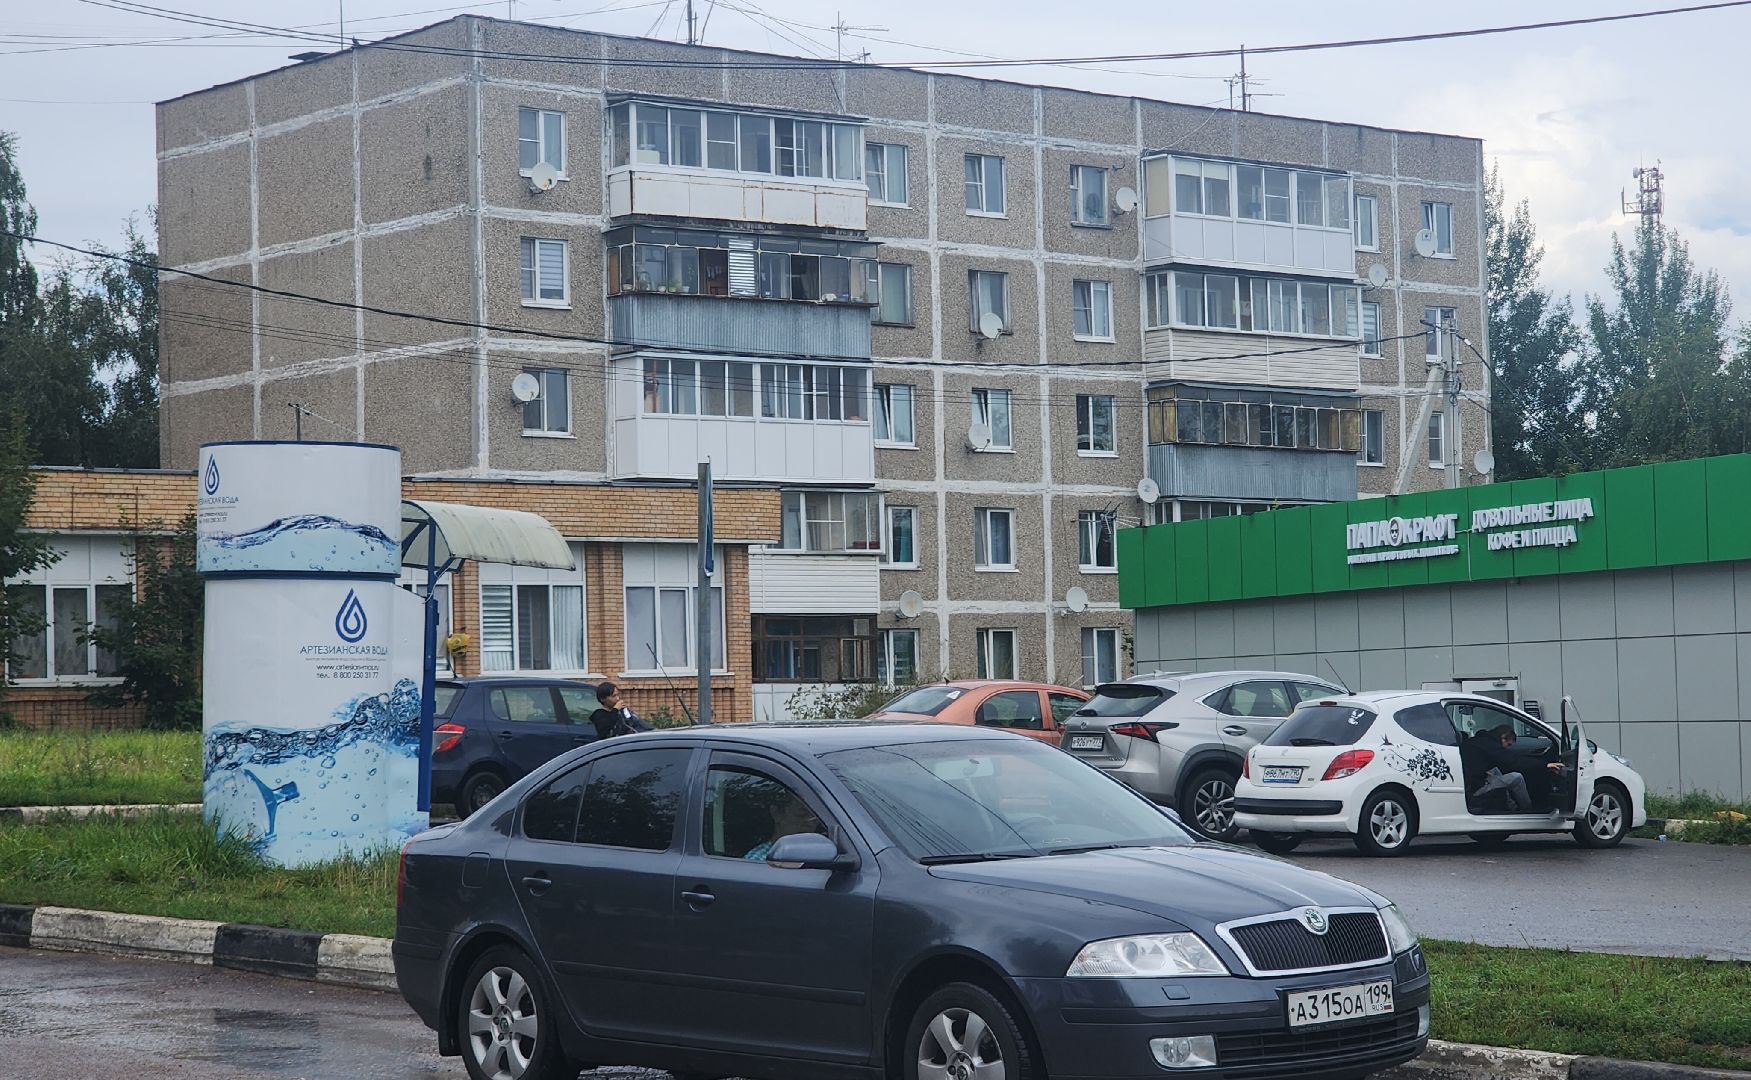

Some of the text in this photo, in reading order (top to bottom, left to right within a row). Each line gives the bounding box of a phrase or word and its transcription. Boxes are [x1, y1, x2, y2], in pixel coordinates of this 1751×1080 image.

[1472, 497, 1594, 533] ДОВОЛЬНЫЕ ЛИЦА
[1487, 525, 1577, 550] КОФЕ И ПИЦЦА
[300, 645, 370, 655] АРТЕЗИАНСКАЯ
[333, 671, 338, 679] 8
[339, 671, 351, 679] 800
[352, 671, 363, 679] 250
[365, 671, 371, 679] 31
[372, 671, 379, 679] 77
[1366, 984, 1388, 1004] 199
[1372, 1003, 1384, 1011] RUS
